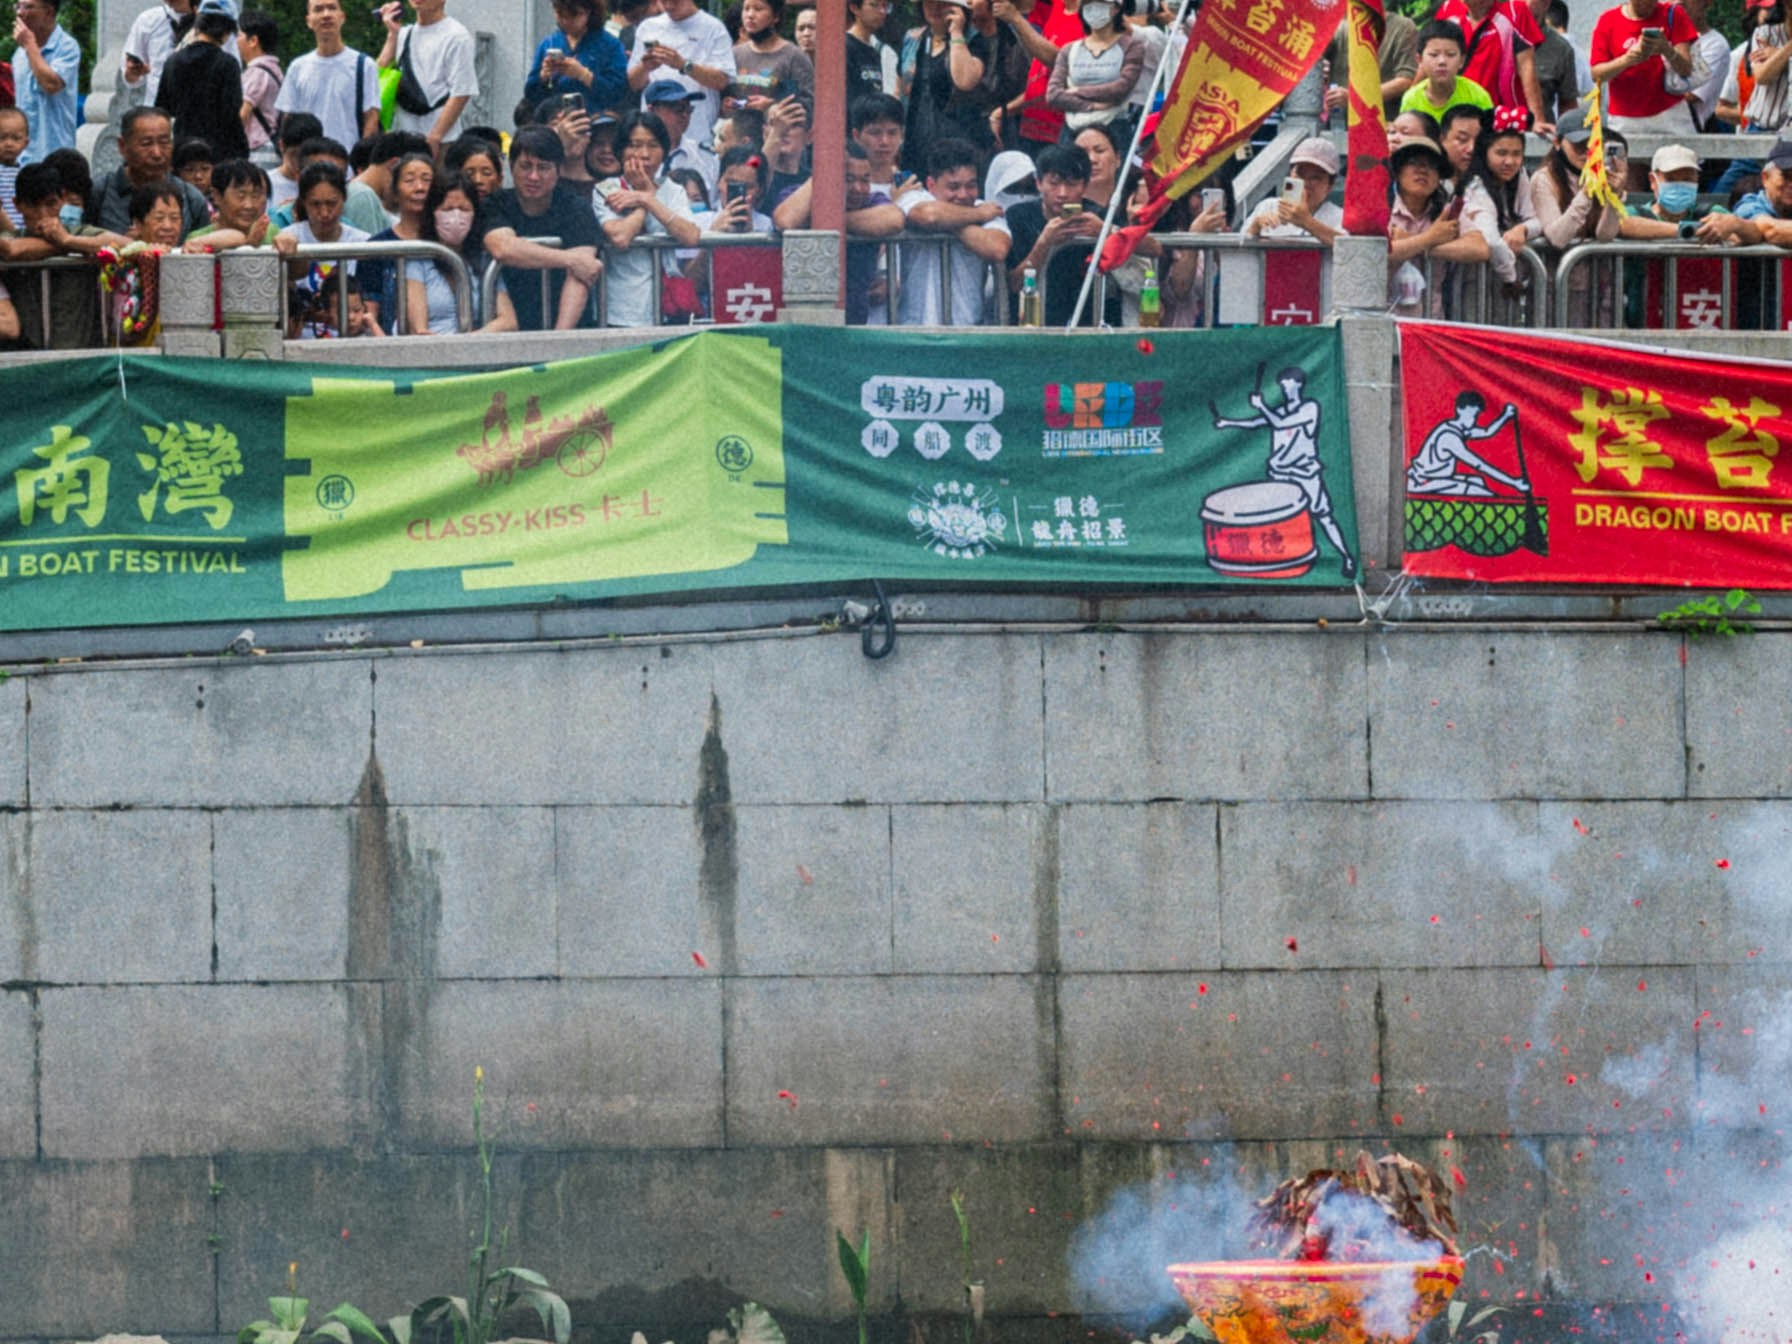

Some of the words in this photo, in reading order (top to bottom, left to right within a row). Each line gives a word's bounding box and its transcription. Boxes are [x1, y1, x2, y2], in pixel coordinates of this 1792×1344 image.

[871, 383, 992, 416] 粤韵广州
[1574, 502, 1696, 532] DRAGON
[1703, 508, 1773, 536] BOAT
[19, 549, 97, 577] BOAT
[108, 547, 246, 575] FESTIVAL
